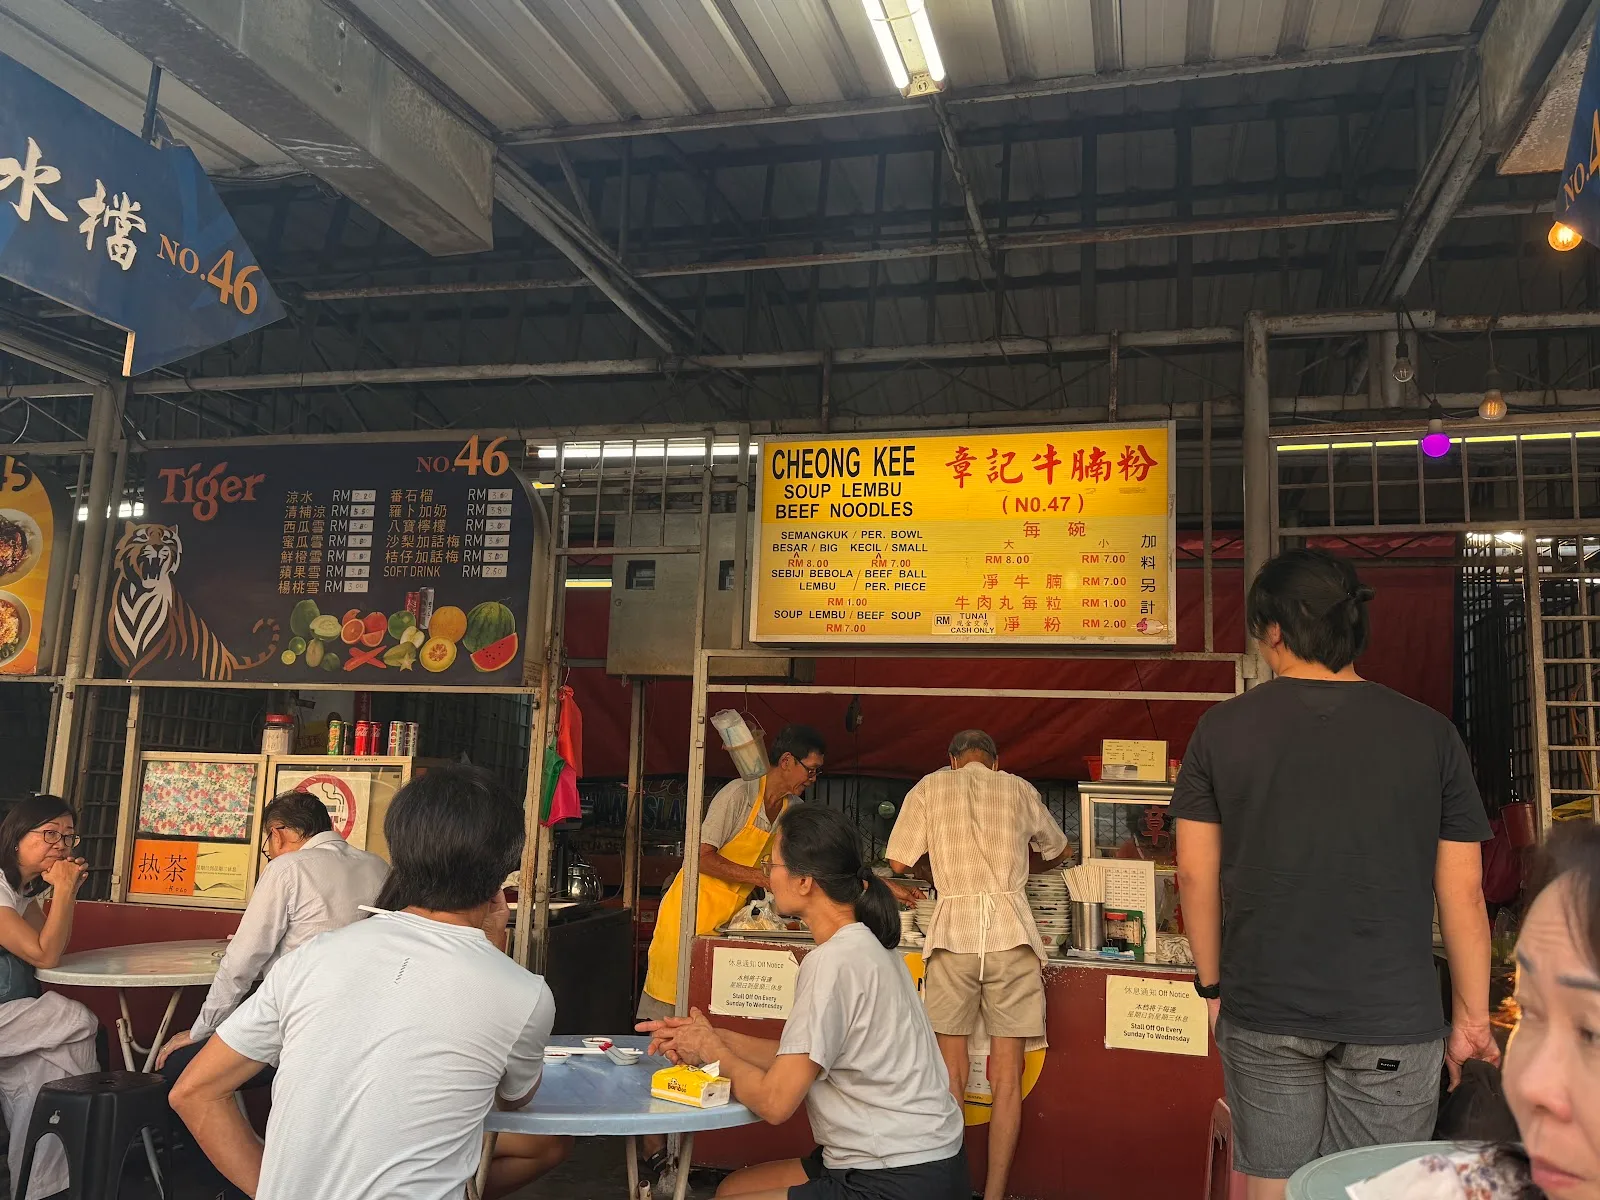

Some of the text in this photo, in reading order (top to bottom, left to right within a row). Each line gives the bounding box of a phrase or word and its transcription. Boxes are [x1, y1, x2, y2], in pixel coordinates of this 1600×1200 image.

[156, 233, 260, 315] NO.46
[416, 435, 509, 476] NO.46
[772, 446, 915, 479] CHEONG KEE
[945, 443, 1158, 489] 章記牛腩粉
[158, 462, 266, 521] Tiger
[333, 490, 350, 501] RM
[390, 489, 433, 503] 番石榴
[468, 488, 486, 501] RM
[784, 482, 902, 499] SOUP LEMBU
[286, 491, 313, 504] 涼水
[331, 505, 349, 517] RM
[467, 503, 485, 516] RM
[776, 502, 913, 519] BEEF NOODLES
[283, 520, 325, 533] 西瓜雪
[330, 520, 347, 531] RM
[465, 519, 484, 531] RM
[328, 535, 346, 547] RM
[464, 534, 483, 547] RM
[781, 531, 848, 540] SEMANGKUK
[861, 531, 886, 539] PER.
[891, 531, 923, 539] BOWL
[282, 535, 323, 549] 蜜瓜雪
[772, 544, 808, 552] BESAR
[820, 544, 838, 552] BIG
[850, 544, 882, 552] KECIL
[891, 544, 928, 552] SMALL
[1004, 539, 1014, 549] 大
[1098, 539, 1109, 548] 小
[280, 550, 322, 564] 鮮橙雪
[327, 550, 345, 562] RM
[463, 549, 482, 562] RM
[985, 555, 1030, 564] RM 8.00
[1082, 555, 1126, 563] RM 7.00
[787, 559, 829, 568] RM 8.00
[871, 559, 911, 568] RM 7.00
[326, 565, 344, 577] RM
[383, 565, 441, 577] SOFT DRINK
[462, 565, 480, 578] RM
[771, 570, 804, 578] SEBIJI
[810, 570, 853, 578] BEBOLA
[865, 570, 893, 578] BEEF
[899, 570, 927, 578] BALL
[1140, 534, 1157, 615] 加料另計
[324, 581, 342, 593] RM
[799, 582, 926, 591] LEMBU PER. PIECE
[1082, 577, 1127, 586] RM 7.00
[828, 598, 867, 606] RM 1.00
[955, 595, 1062, 611] 牛肉丸每粒
[1082, 599, 1127, 608] RM 1.00
[774, 610, 803, 619] SOUP
[809, 611, 846, 619] LEMBU
[857, 611, 885, 620] BEEF
[891, 612, 921, 620] SOUP
[936, 616, 950, 624] RM
[960, 612, 987, 620] TUNAI
[826, 624, 866, 632] RM 7.00
[1082, 619, 1127, 628] RM 2.00
[137, 852, 187, 883] 热茶
[766, 961, 784, 969] Notice
[1124, 986, 1190, 999] 休息通知 Off Notice
[726, 1000, 745, 1008] Sunday
[753, 1002, 783, 1010] Wednesday
[1165, 1026, 1183, 1034] Every
[1123, 1030, 1146, 1039] Sunday
[1155, 1033, 1190, 1044] Wednesday
